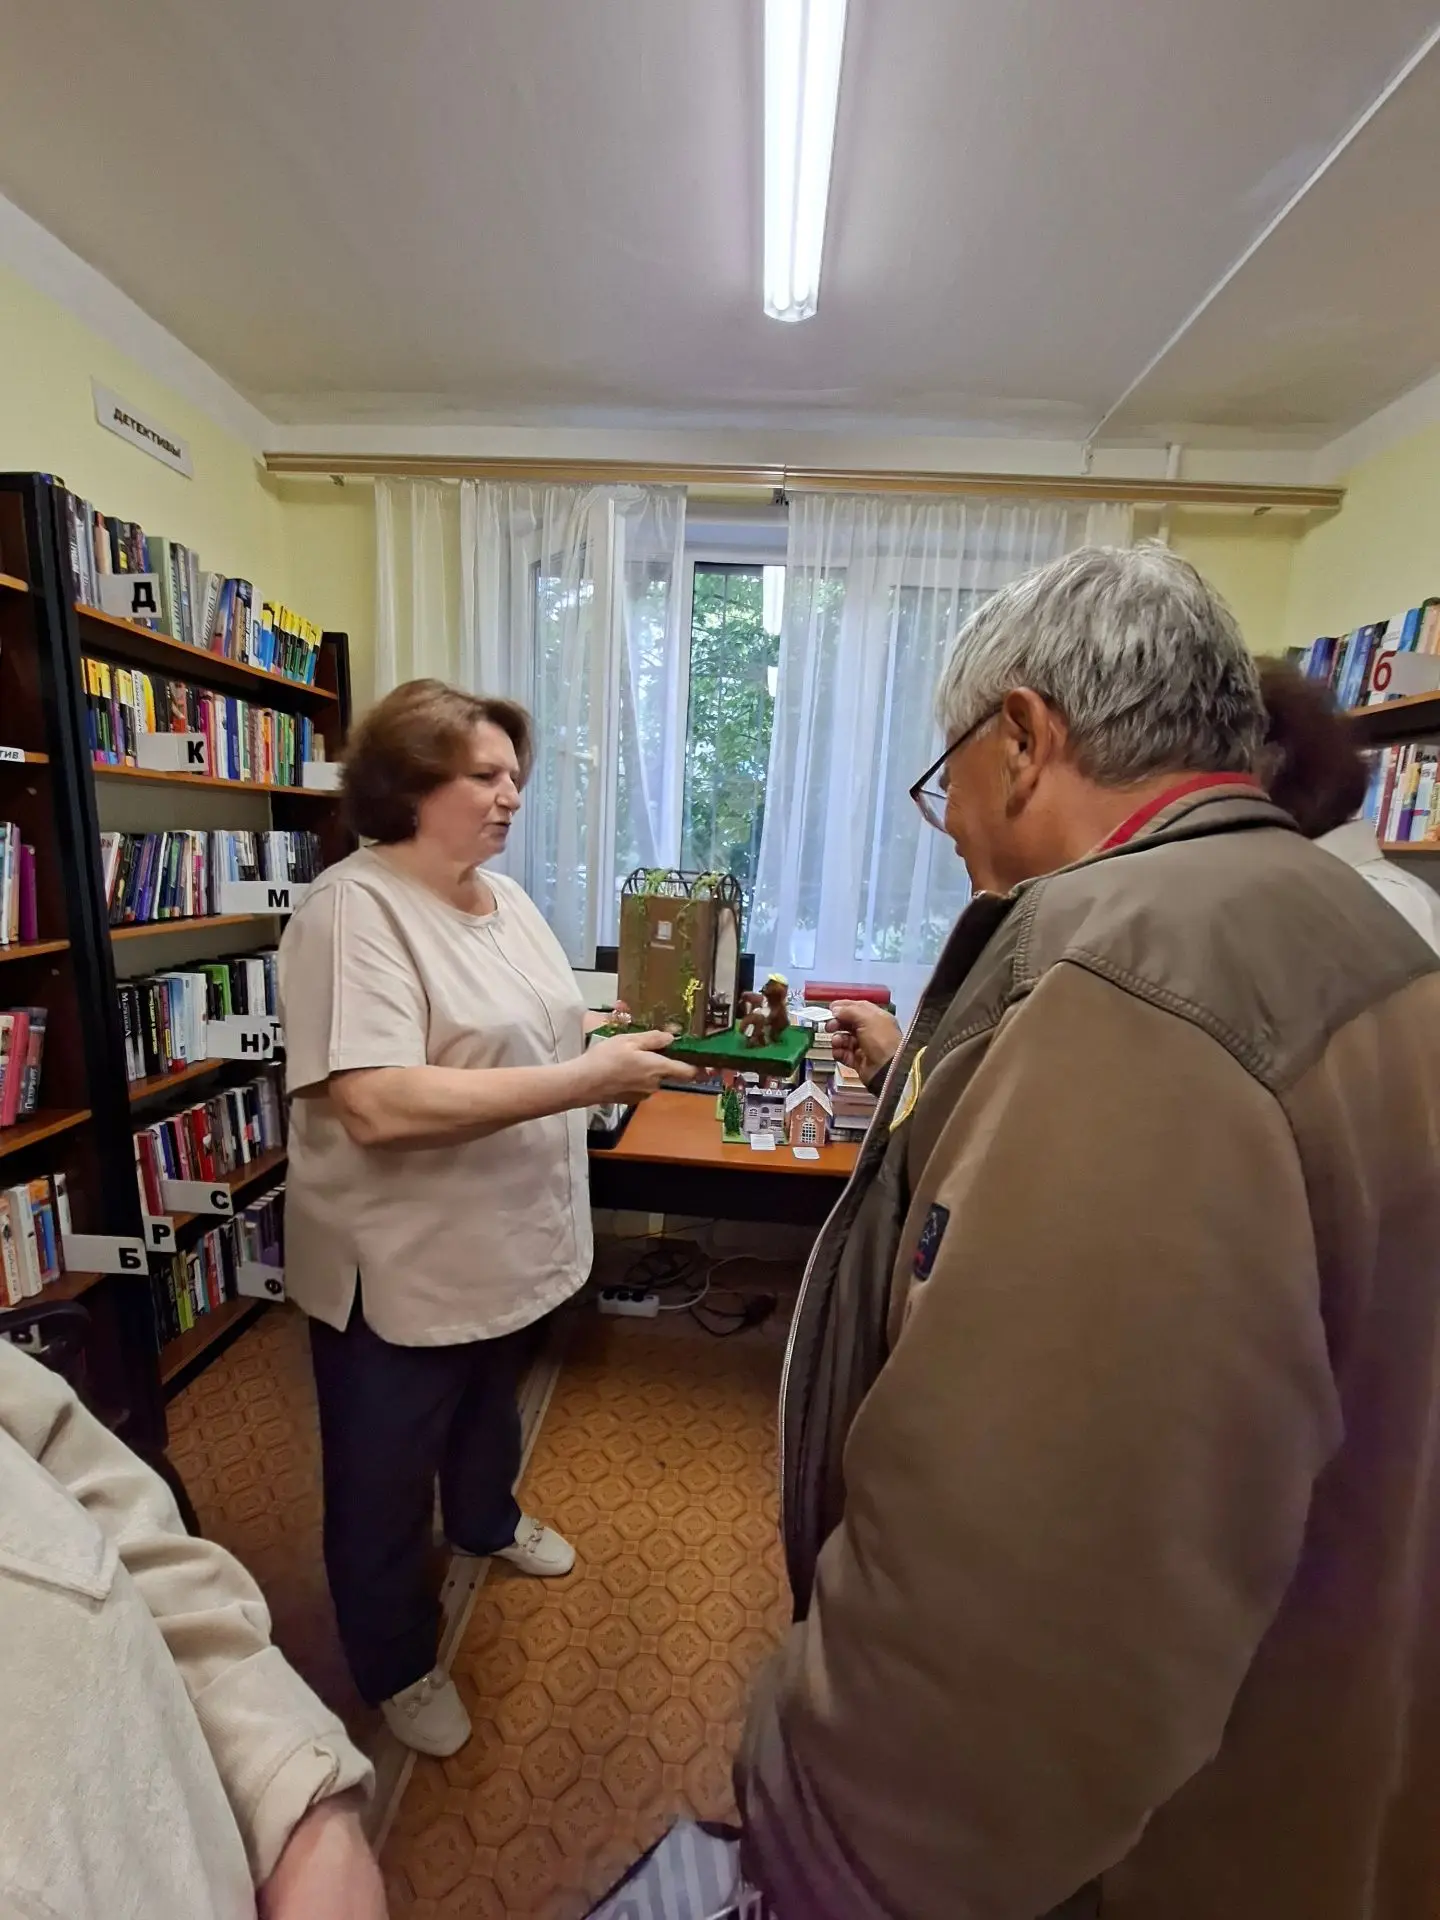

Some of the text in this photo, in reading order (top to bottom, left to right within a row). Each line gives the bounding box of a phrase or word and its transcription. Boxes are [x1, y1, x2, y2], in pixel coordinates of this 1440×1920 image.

[113, 407, 181, 459] ДЕТЕКТИВЫ
[131, 582, 157, 613] Д
[187, 740, 205, 763] К
[267, 889, 290, 907] М
[241, 1033, 259, 1052] Н
[210, 1190, 230, 1210] С
[151, 1223, 171, 1244] Р
[118, 1248, 141, 1270] Б
